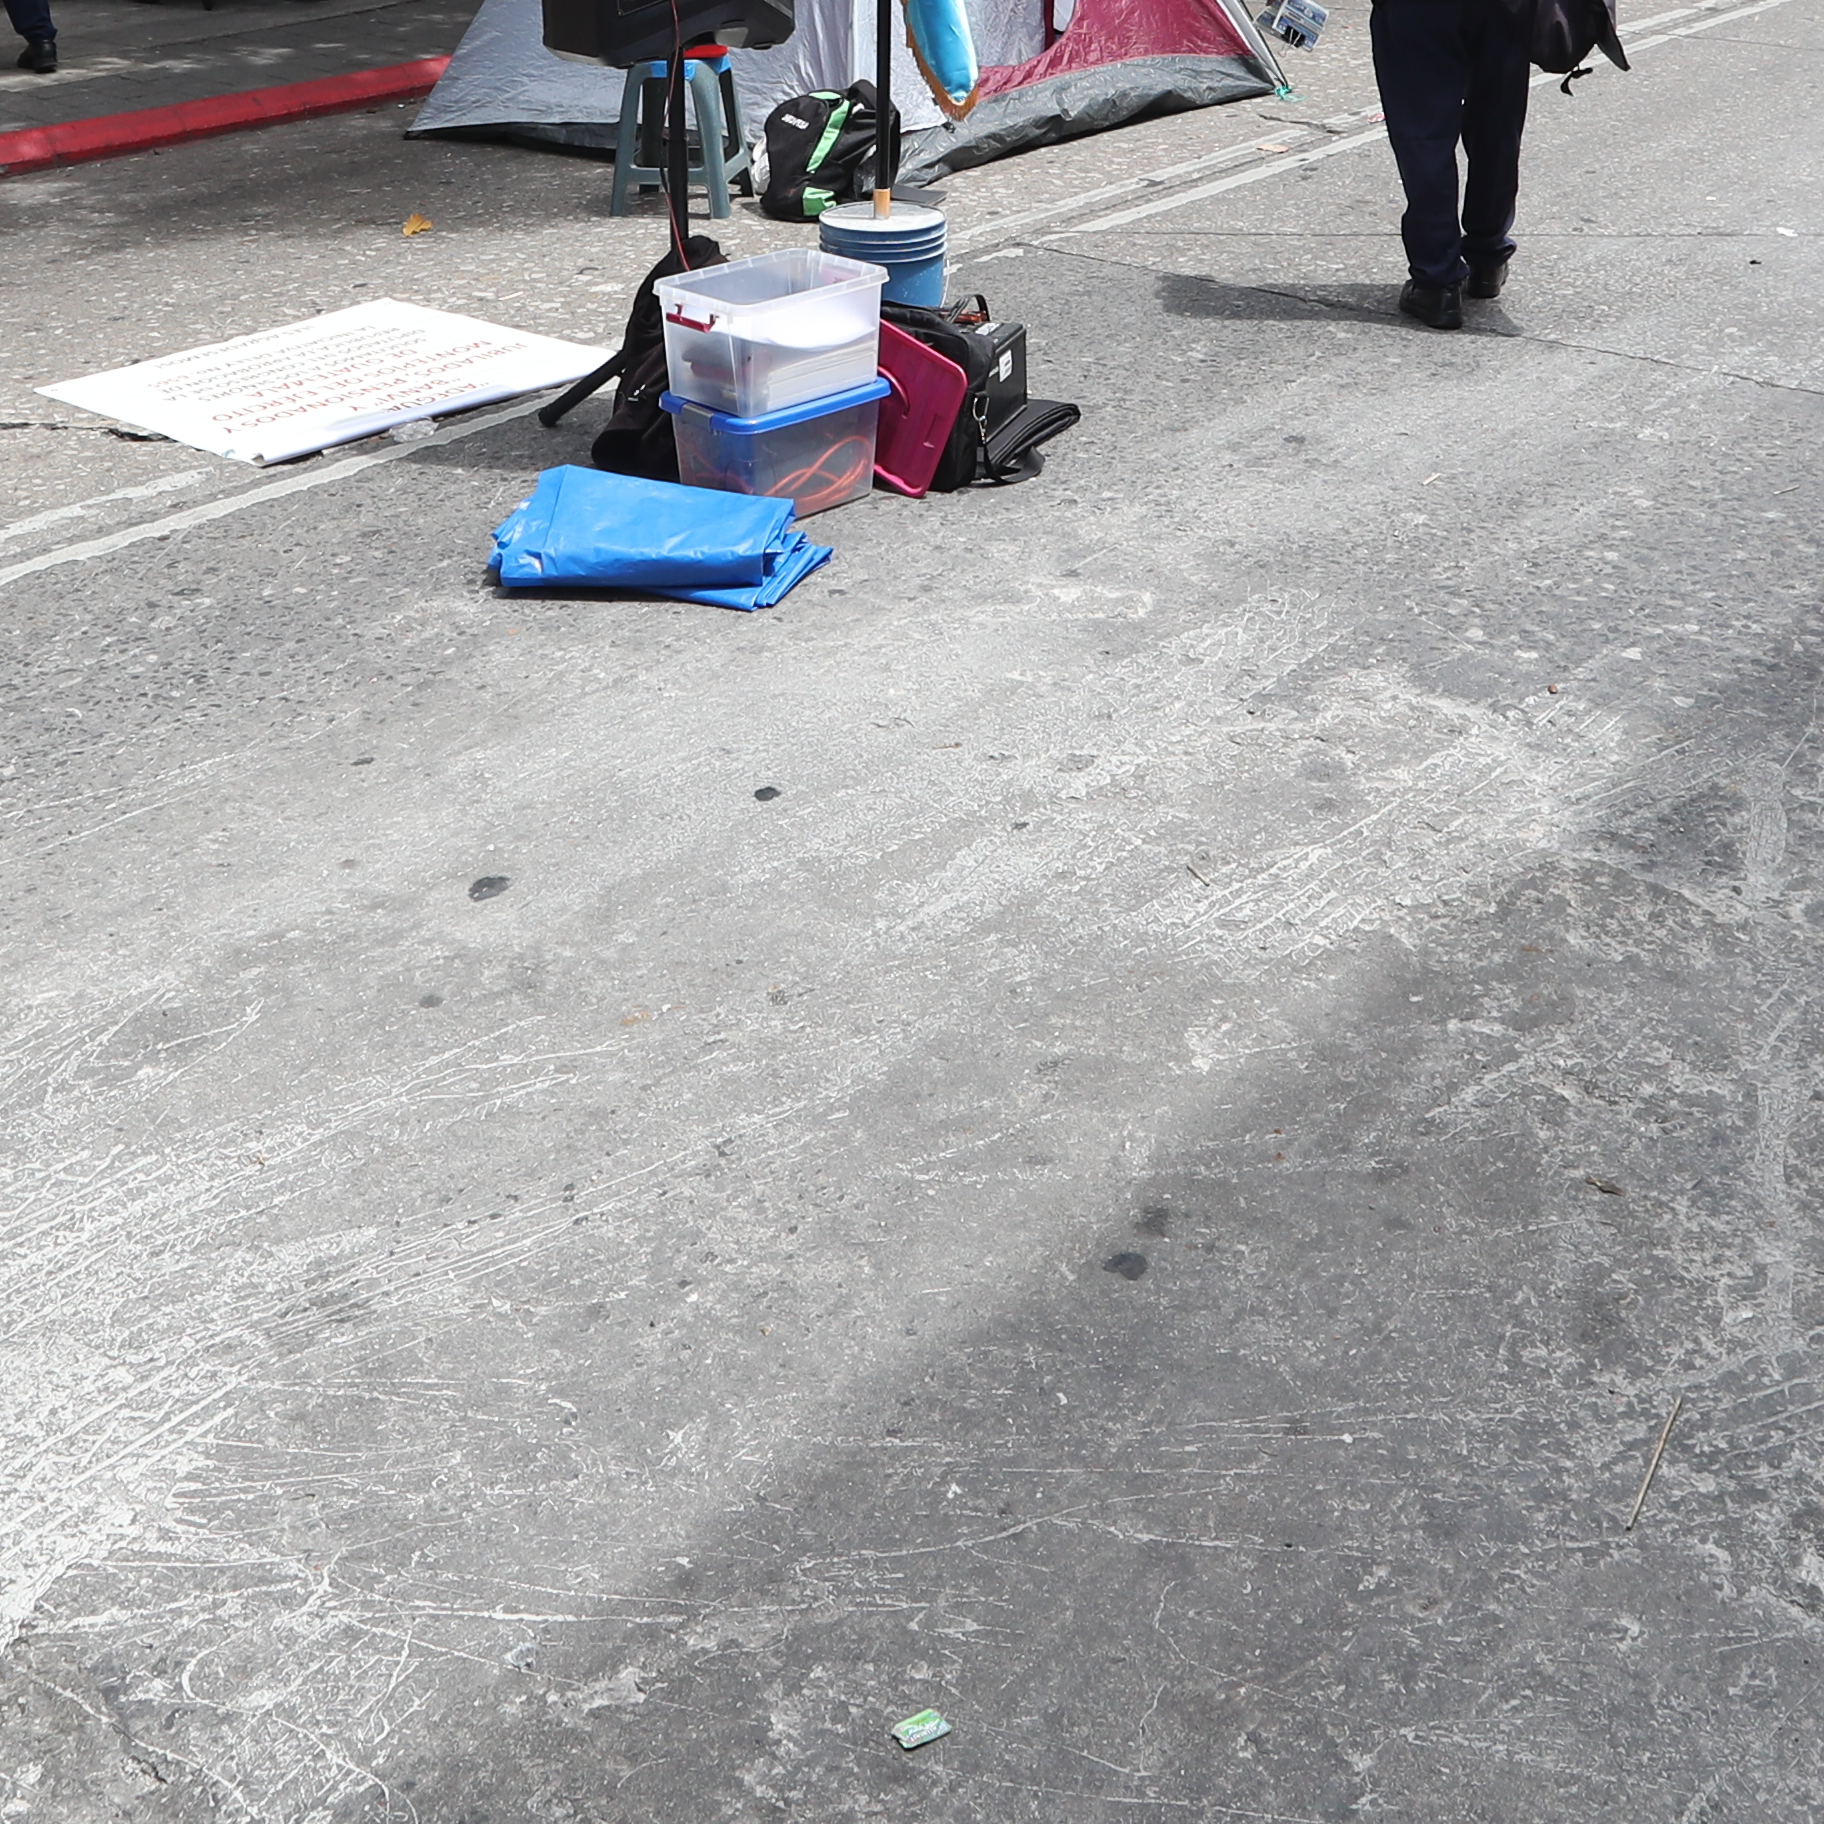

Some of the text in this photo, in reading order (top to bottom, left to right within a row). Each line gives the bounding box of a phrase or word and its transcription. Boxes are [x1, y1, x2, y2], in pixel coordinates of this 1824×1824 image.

[241, 348, 420, 399] DE GUATEMALA
[312, 376, 367, 392] DEL
[236, 377, 410, 429] PENSIONADOS
[215, 426, 242, 434] Y
